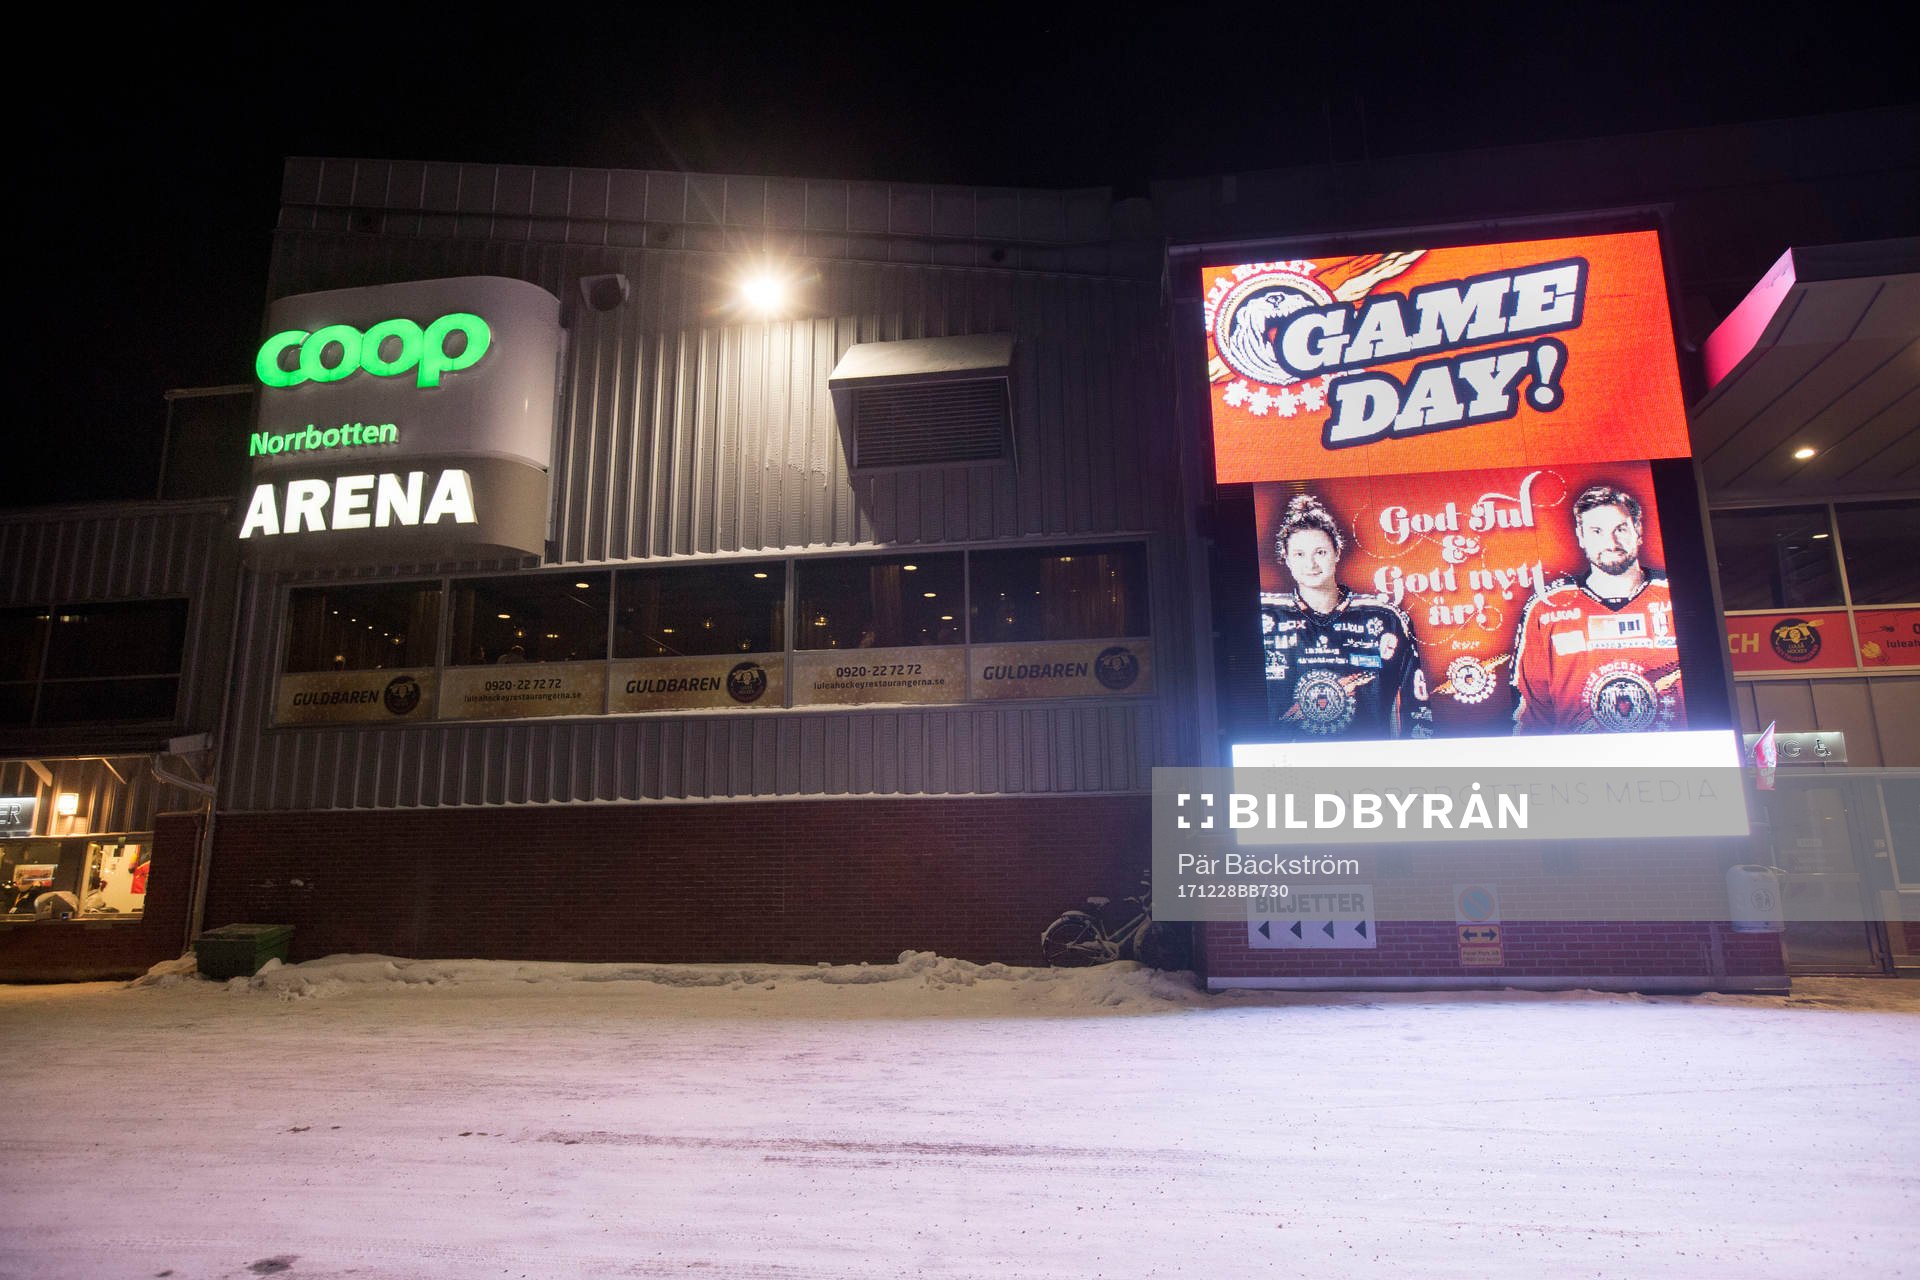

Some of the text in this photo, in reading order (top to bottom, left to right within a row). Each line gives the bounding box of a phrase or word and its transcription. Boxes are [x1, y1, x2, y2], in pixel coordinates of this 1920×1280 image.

[1281, 264, 1581, 371] GAME
[256, 313, 491, 388] coop
[1329, 345, 1561, 443] DAY!
[250, 423, 398, 456] Norrbotten
[239, 469, 478, 539] ARENA
[1379, 471, 1542, 545] God Jul
[1442, 535, 1480, 564] &
[1373, 560, 1550, 606] Gott nytt
[1429, 593, 1488, 626] är!
[626, 677, 721, 694] GULDBAREN
[983, 662, 1088, 680] GULDBAREN
[293, 690, 380, 706] GULDBAREN
[1604, 778, 1719, 807] MEDIA
[1255, 893, 1365, 914] BILJETTER
